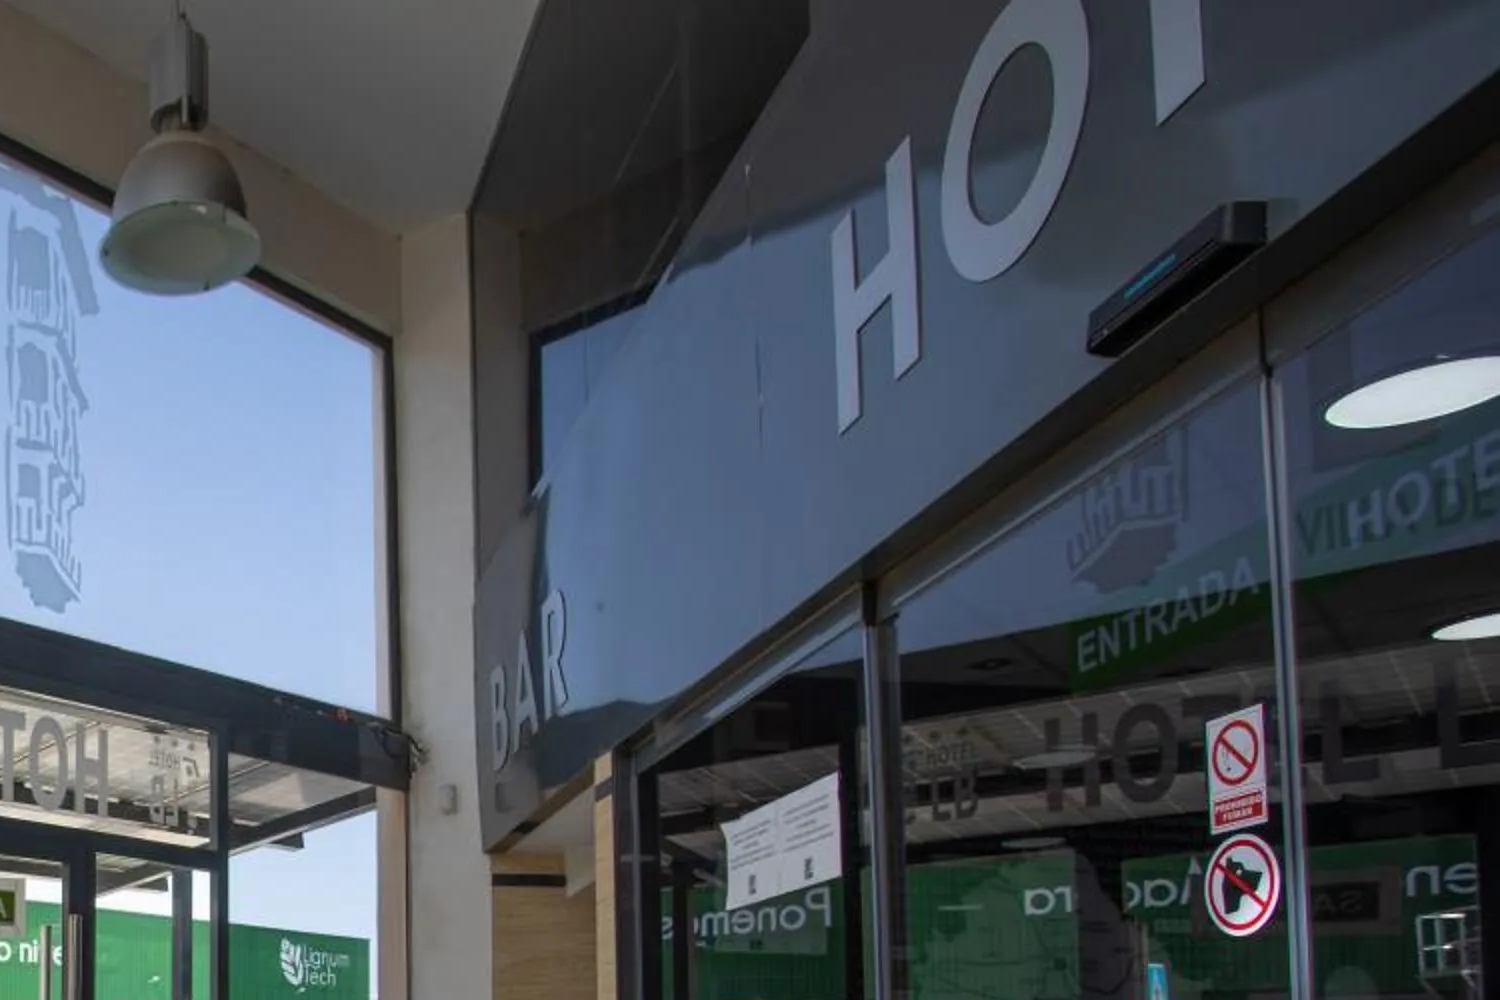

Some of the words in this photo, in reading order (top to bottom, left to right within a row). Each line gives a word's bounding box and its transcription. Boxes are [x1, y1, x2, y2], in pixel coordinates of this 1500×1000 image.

[1076, 556, 1261, 674] ENTRADA
[489, 588, 569, 774] BAR
[302, 944, 350, 968] Lignum
[302, 965, 338, 987] Tech
